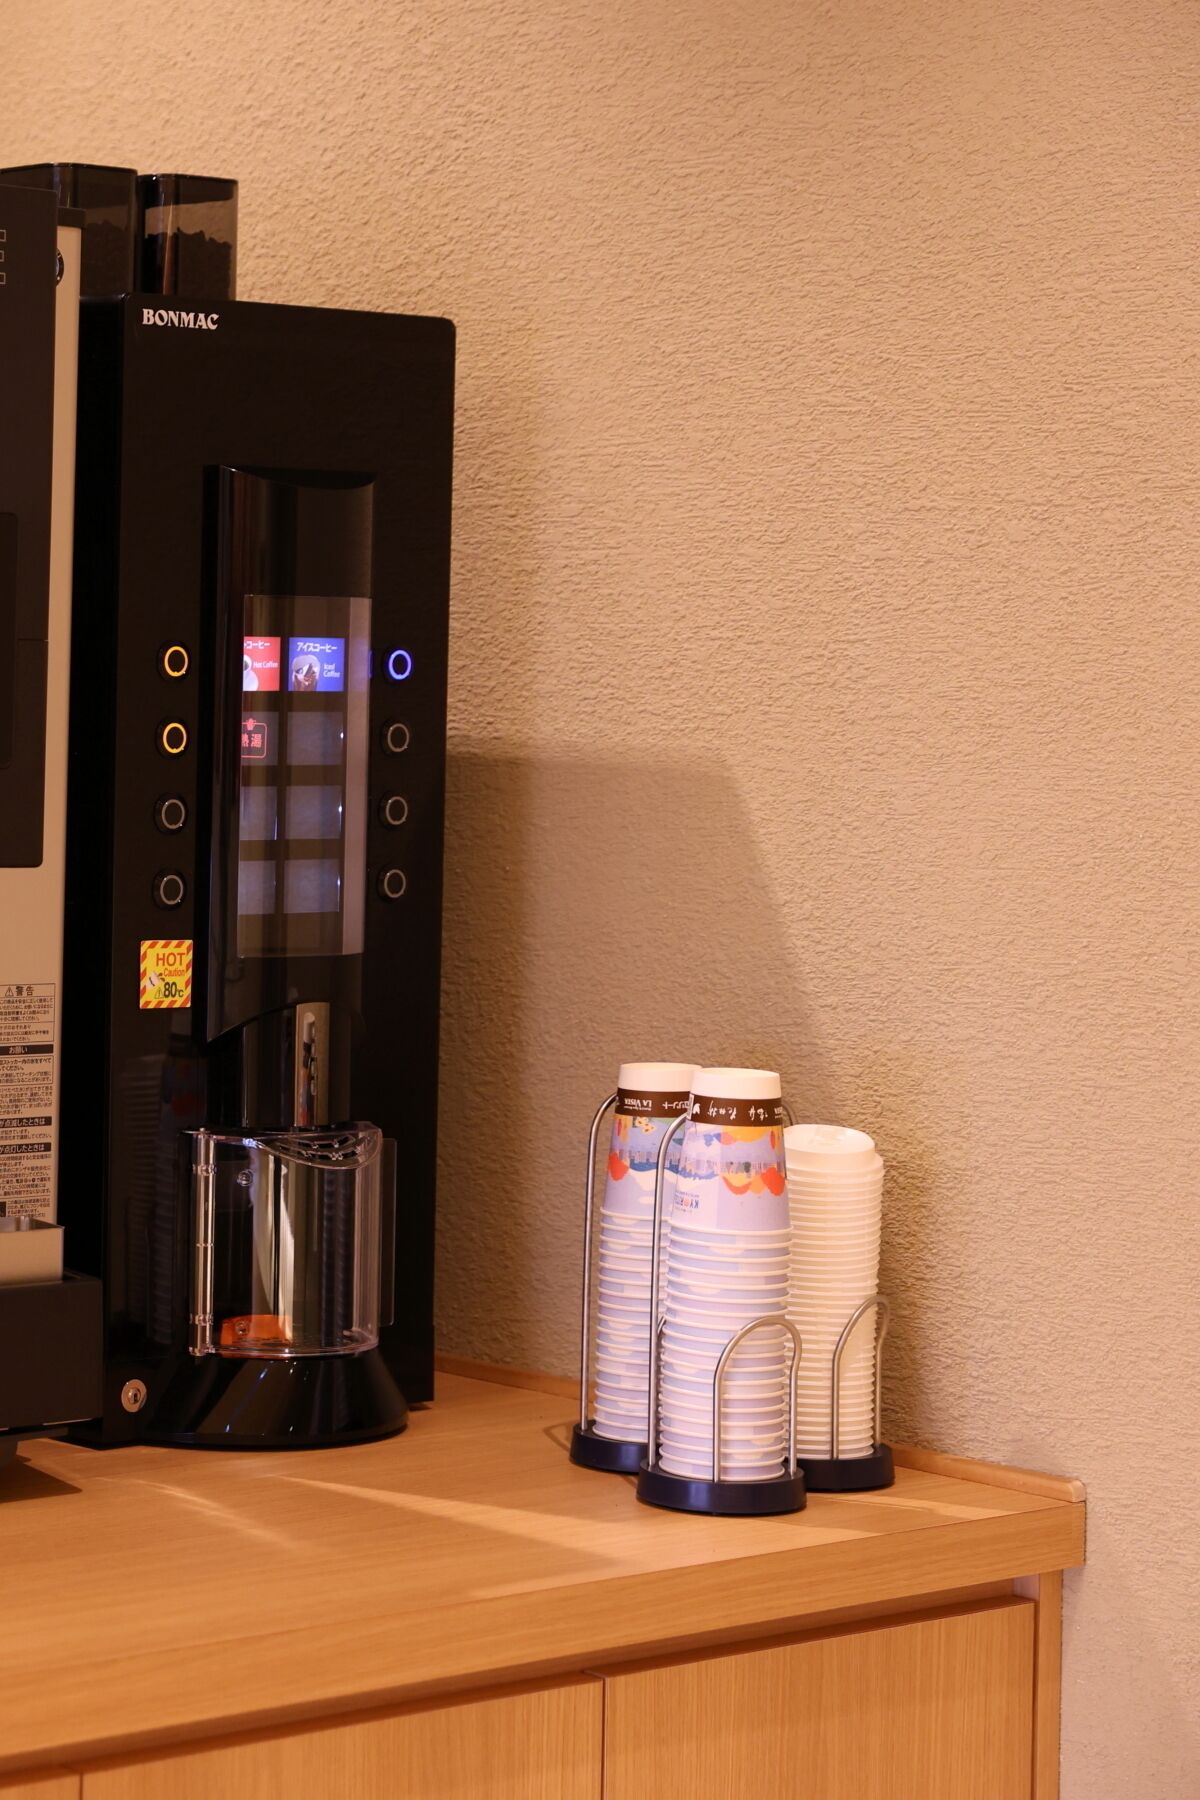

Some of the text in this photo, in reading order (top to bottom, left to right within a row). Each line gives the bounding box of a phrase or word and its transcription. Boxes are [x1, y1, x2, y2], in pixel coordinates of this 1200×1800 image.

[142, 308, 219, 330] BONMAC
[296, 641, 338, 653] アイスコーヒー
[156, 952, 186, 967] HOT
[164, 968, 185, 977] Caution
[15, 985, 34, 996] 警告
